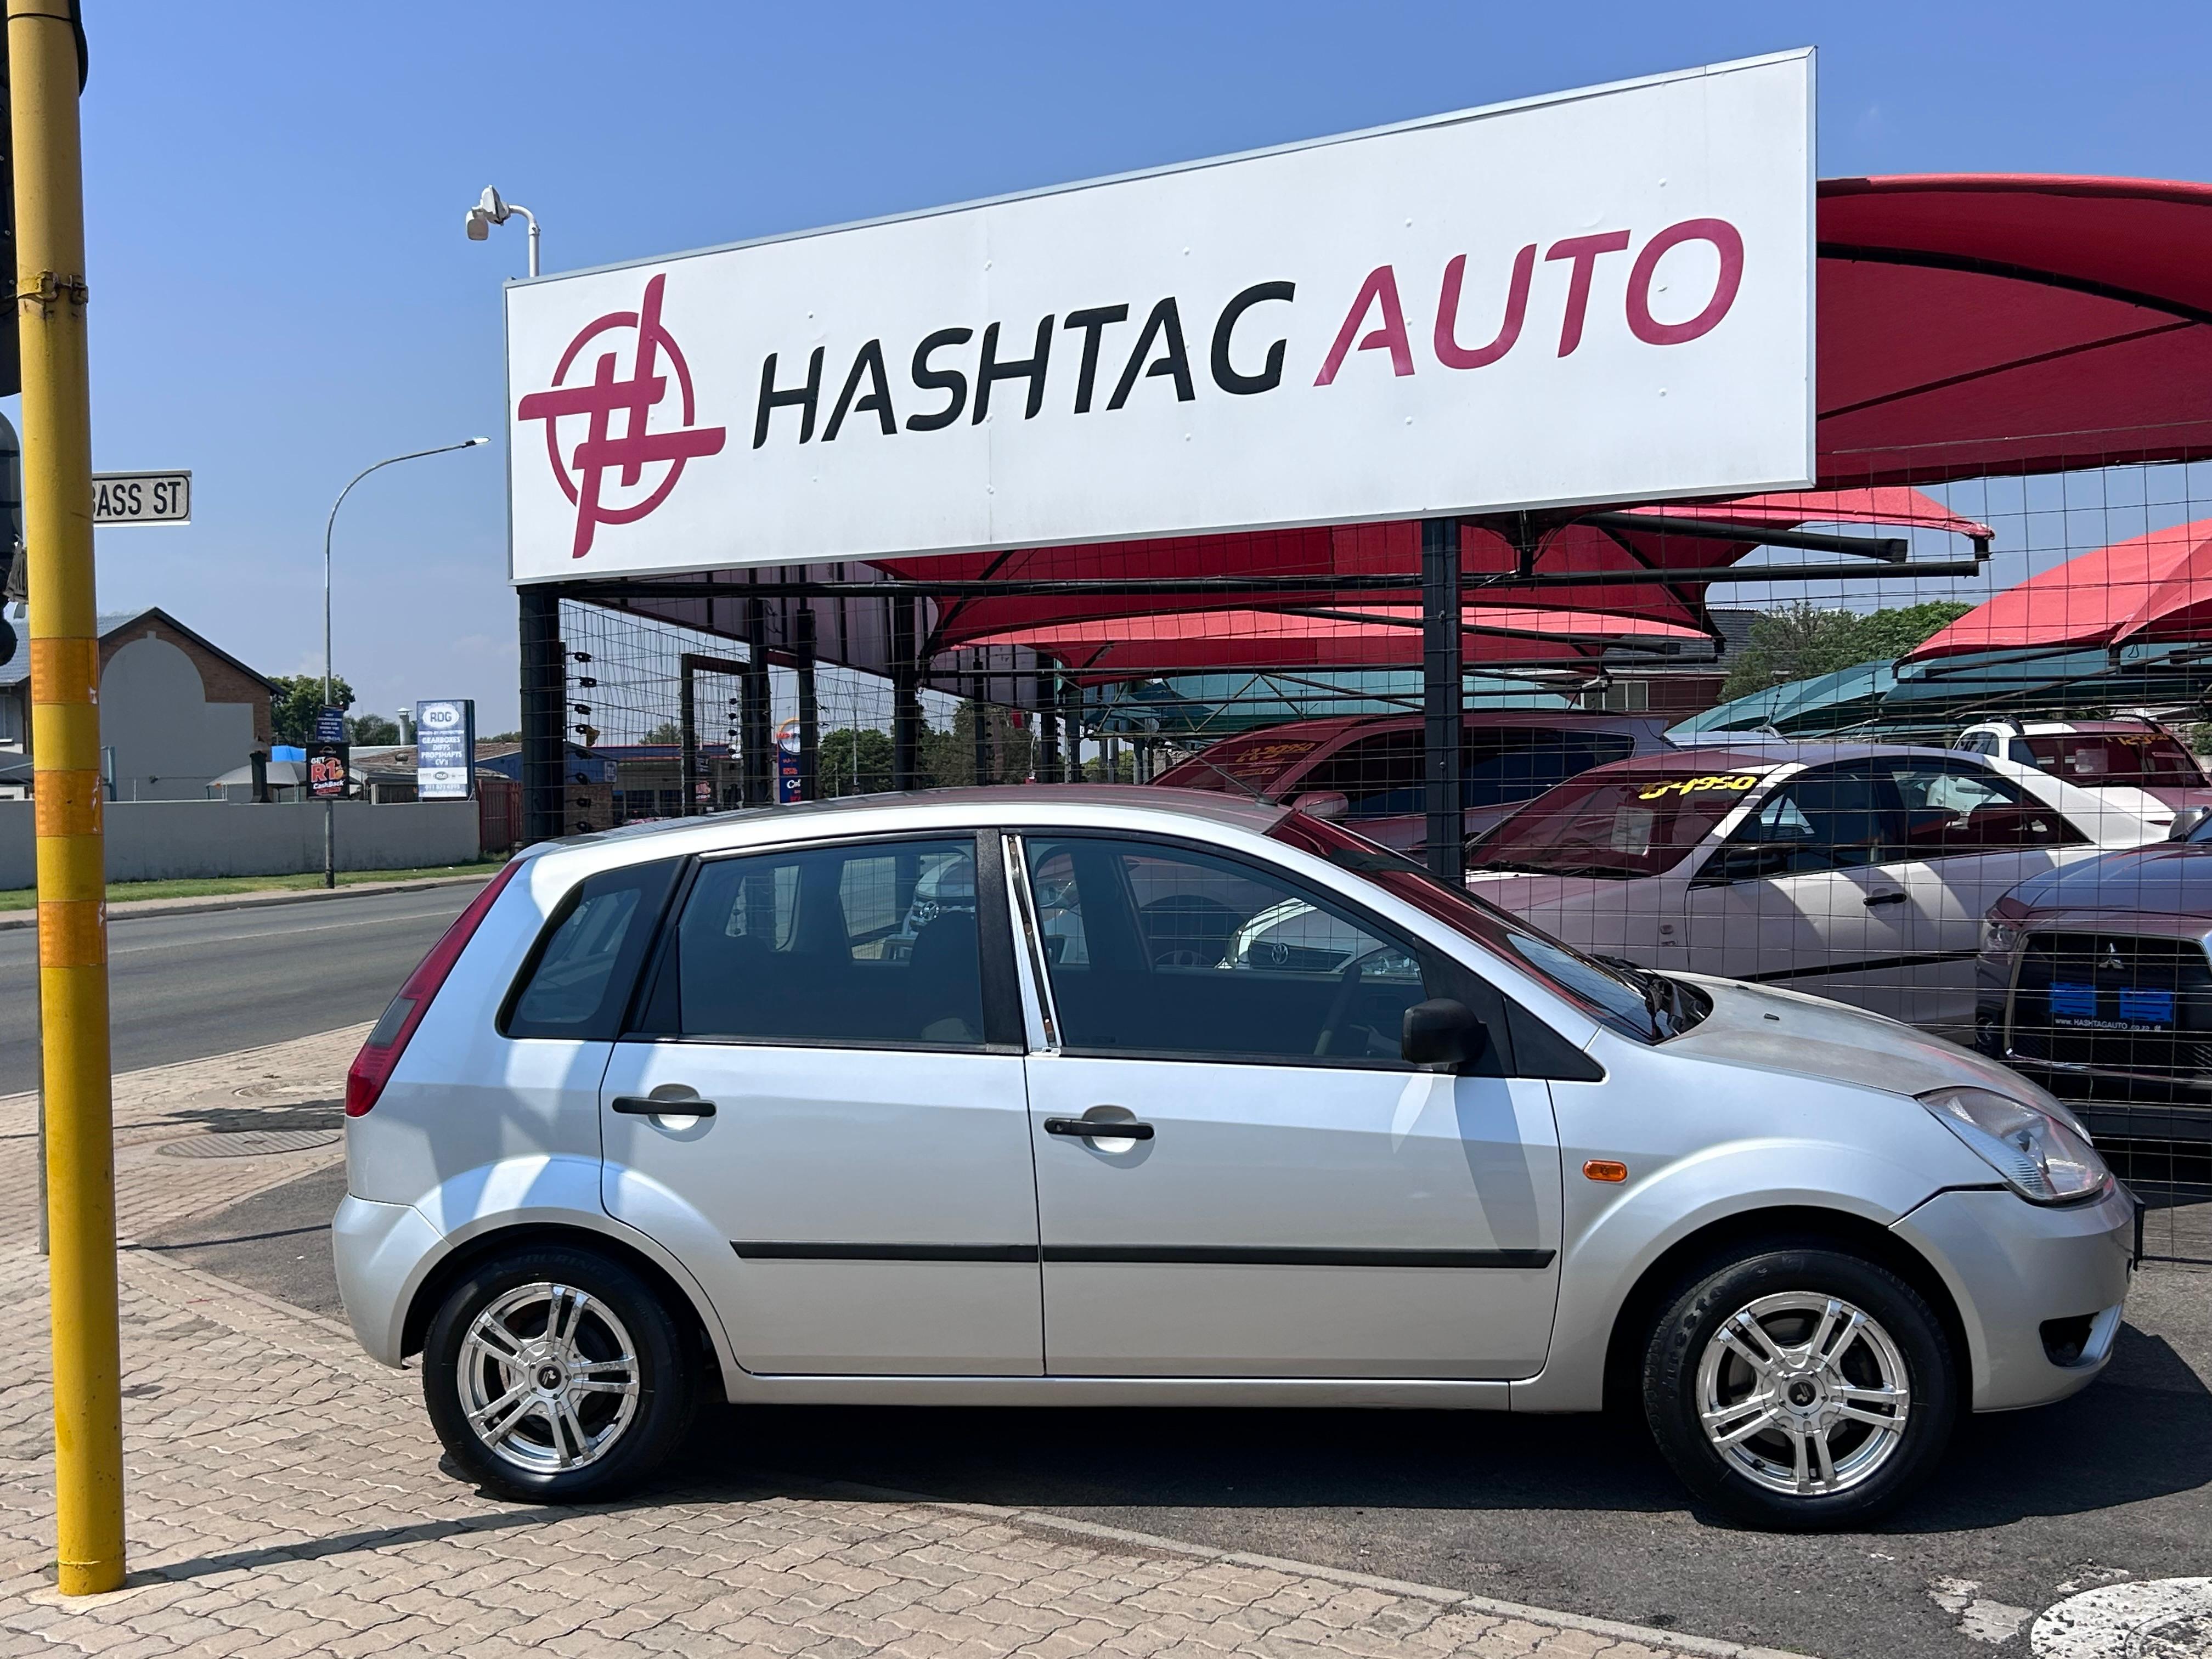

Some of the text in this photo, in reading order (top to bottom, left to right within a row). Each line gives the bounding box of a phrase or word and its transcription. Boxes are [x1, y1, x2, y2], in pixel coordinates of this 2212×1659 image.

[752, 217, 1745, 450] HASHTAG AUTO
[92, 482, 181, 517] ASS ST
[430, 712, 453, 723] RDG
[2074, 1019, 2128, 1029] HASHTAGAUTO
